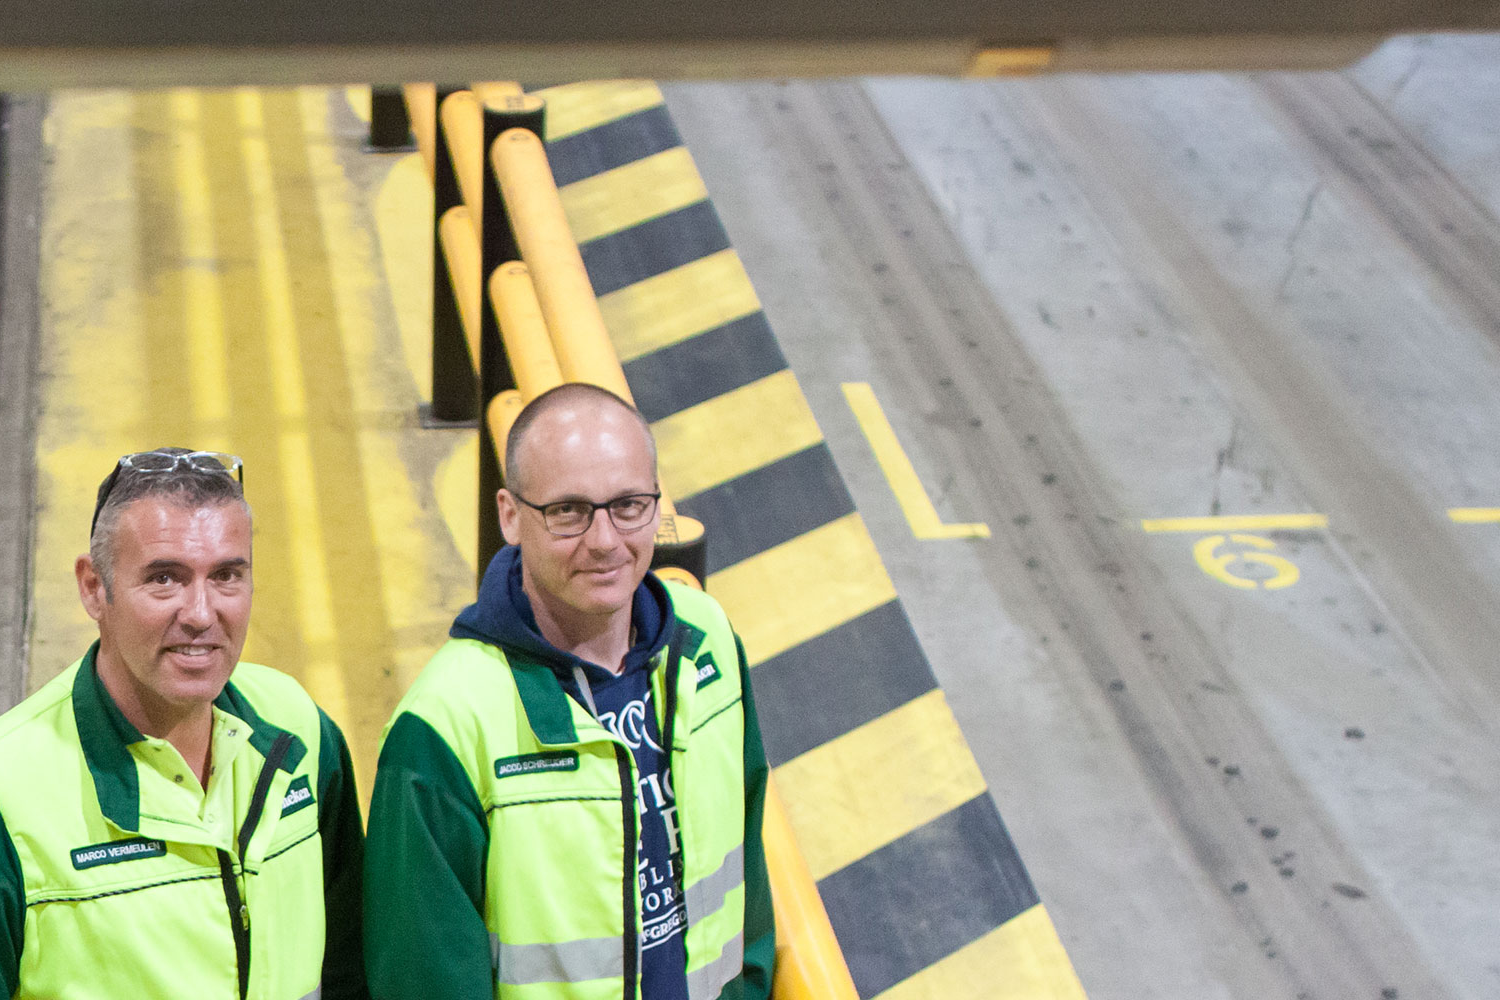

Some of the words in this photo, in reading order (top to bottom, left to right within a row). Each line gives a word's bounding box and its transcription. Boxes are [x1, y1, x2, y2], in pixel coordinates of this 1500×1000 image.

[1193, 534, 1300, 589] 6
[76, 849, 107, 863] MARCO
[107, 841, 161, 857] VERMEULEN
